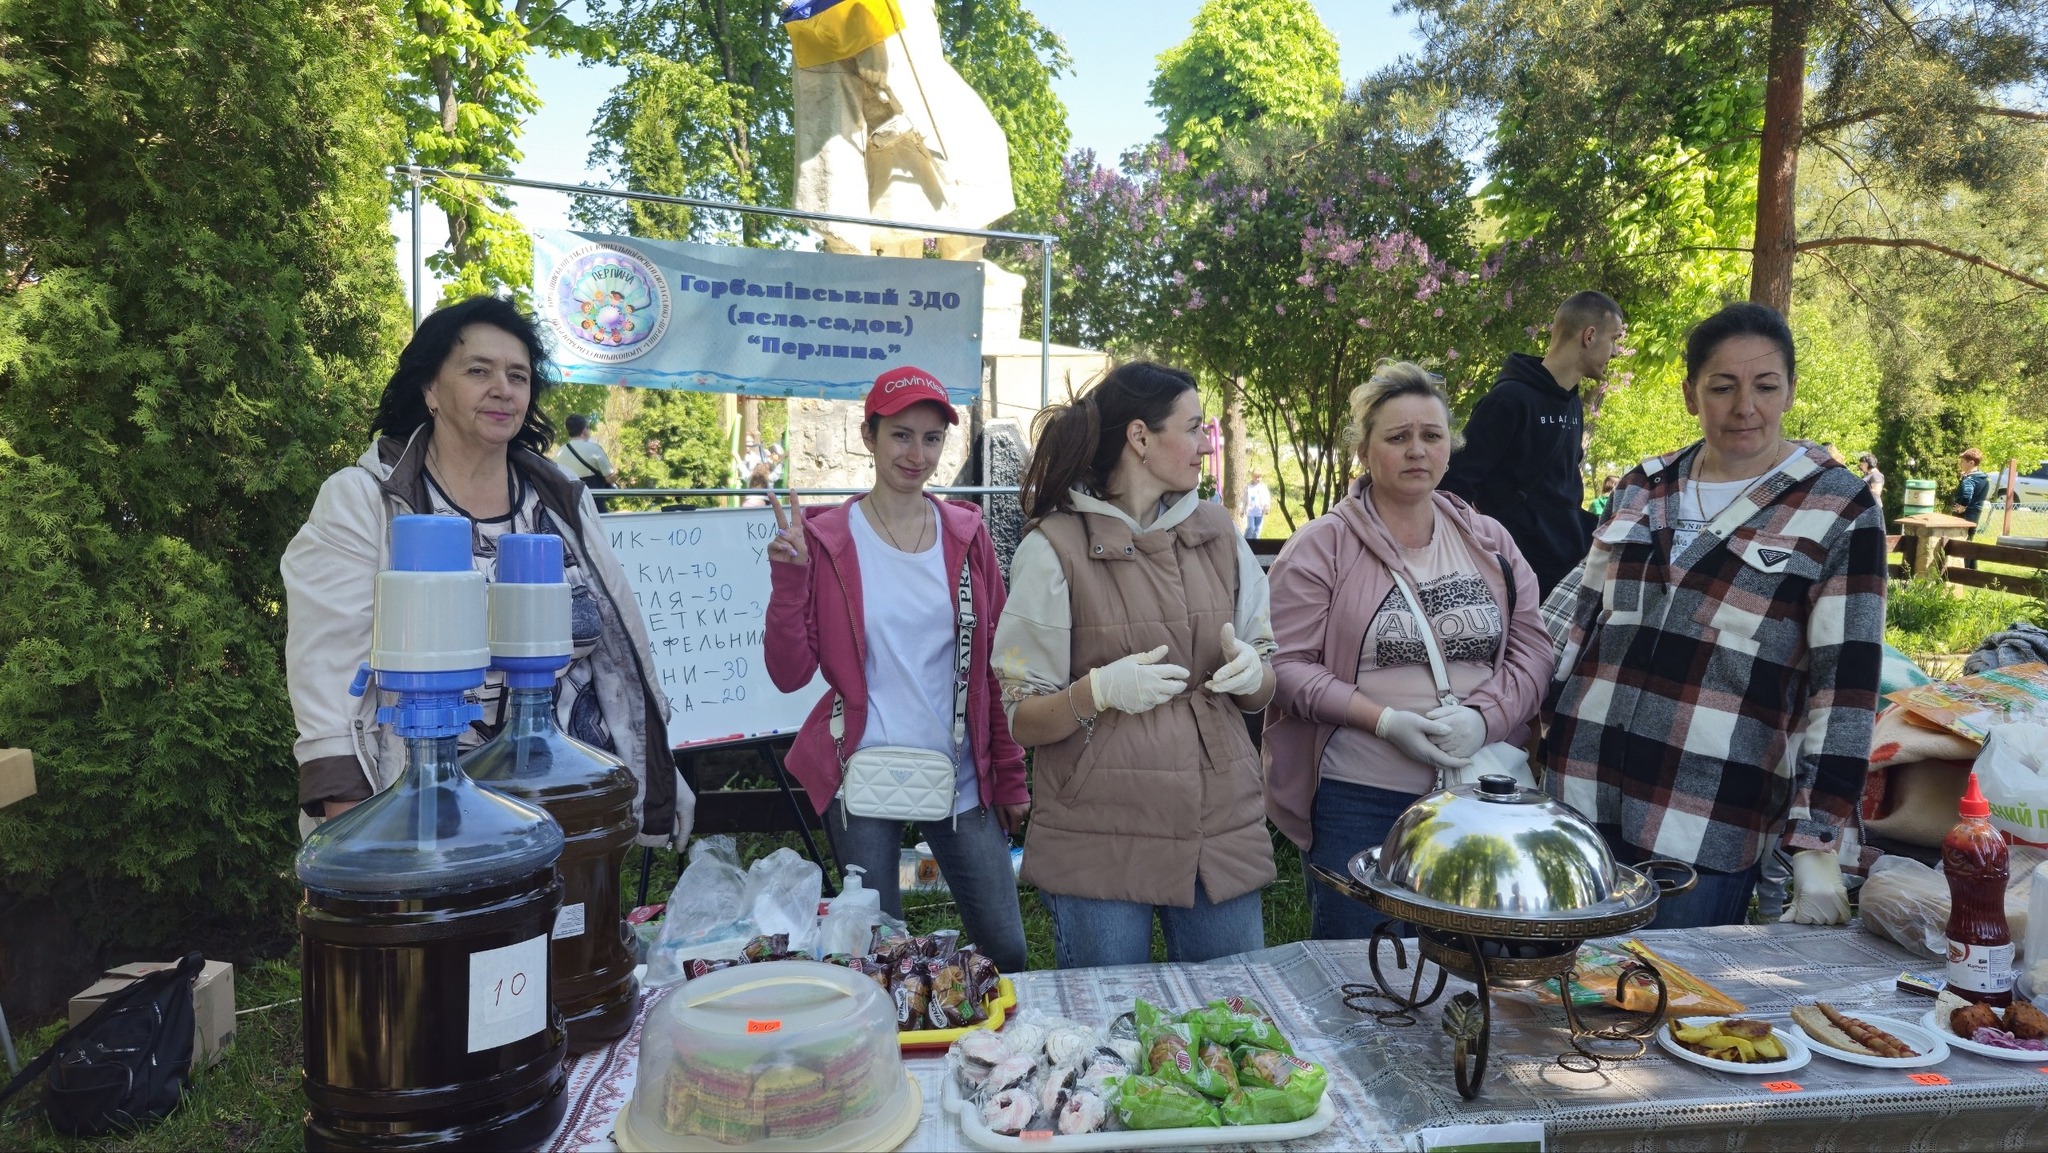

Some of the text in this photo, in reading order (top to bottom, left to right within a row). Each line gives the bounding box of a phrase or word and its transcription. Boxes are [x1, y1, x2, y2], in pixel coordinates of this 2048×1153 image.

[591, 268, 635, 285] ПЕРЛИНА
[680, 274, 961, 311] Горбанівський ЗДО
[727, 304, 913, 337] (ясла-садок)
[884, 375, 925, 394] Calvin
[493, 973, 527, 1007] 10
[1770, 1082, 1793, 1090] 50
[1913, 1074, 1941, 1084] 70
